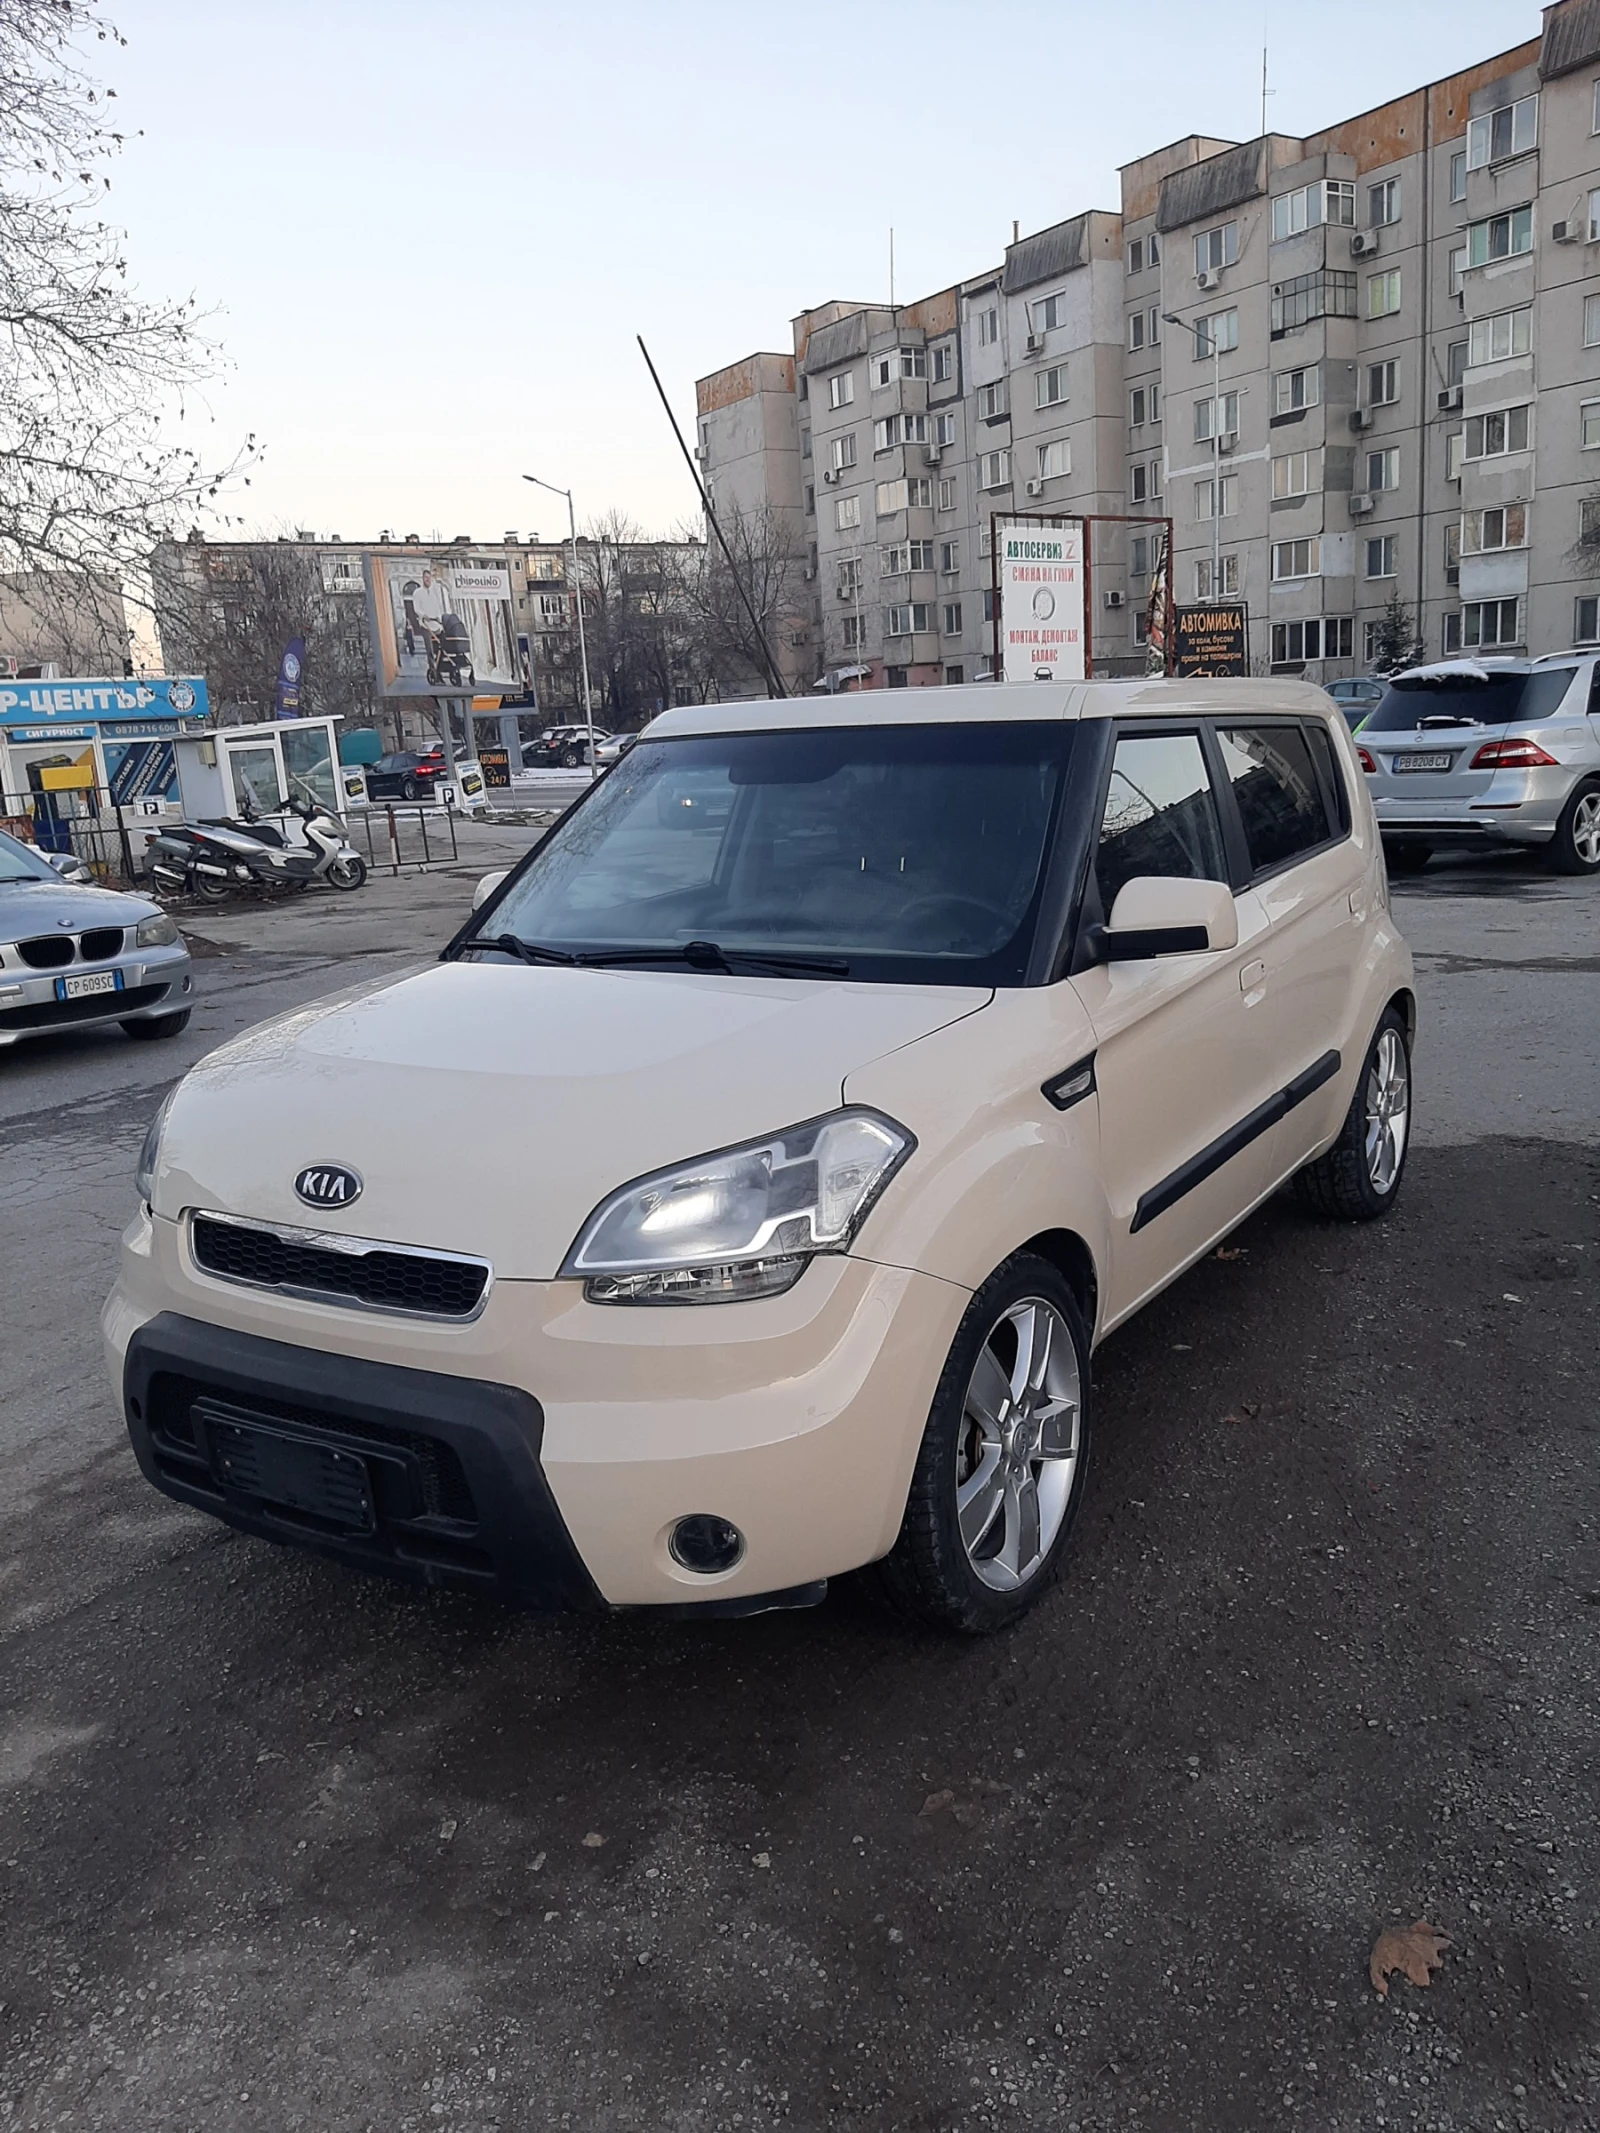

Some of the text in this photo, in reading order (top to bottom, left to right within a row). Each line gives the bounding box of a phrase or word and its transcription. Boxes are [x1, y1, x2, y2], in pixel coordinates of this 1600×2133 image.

[1007, 541, 1062, 559] АВТОСЕРВИЗ
[1180, 612, 1241, 633] АВТОМИВКА
[26, 727, 85, 738] СИГУРНОСТ
[67, 981, 80, 994] CP
[302, 1171, 345, 1200] KIA
